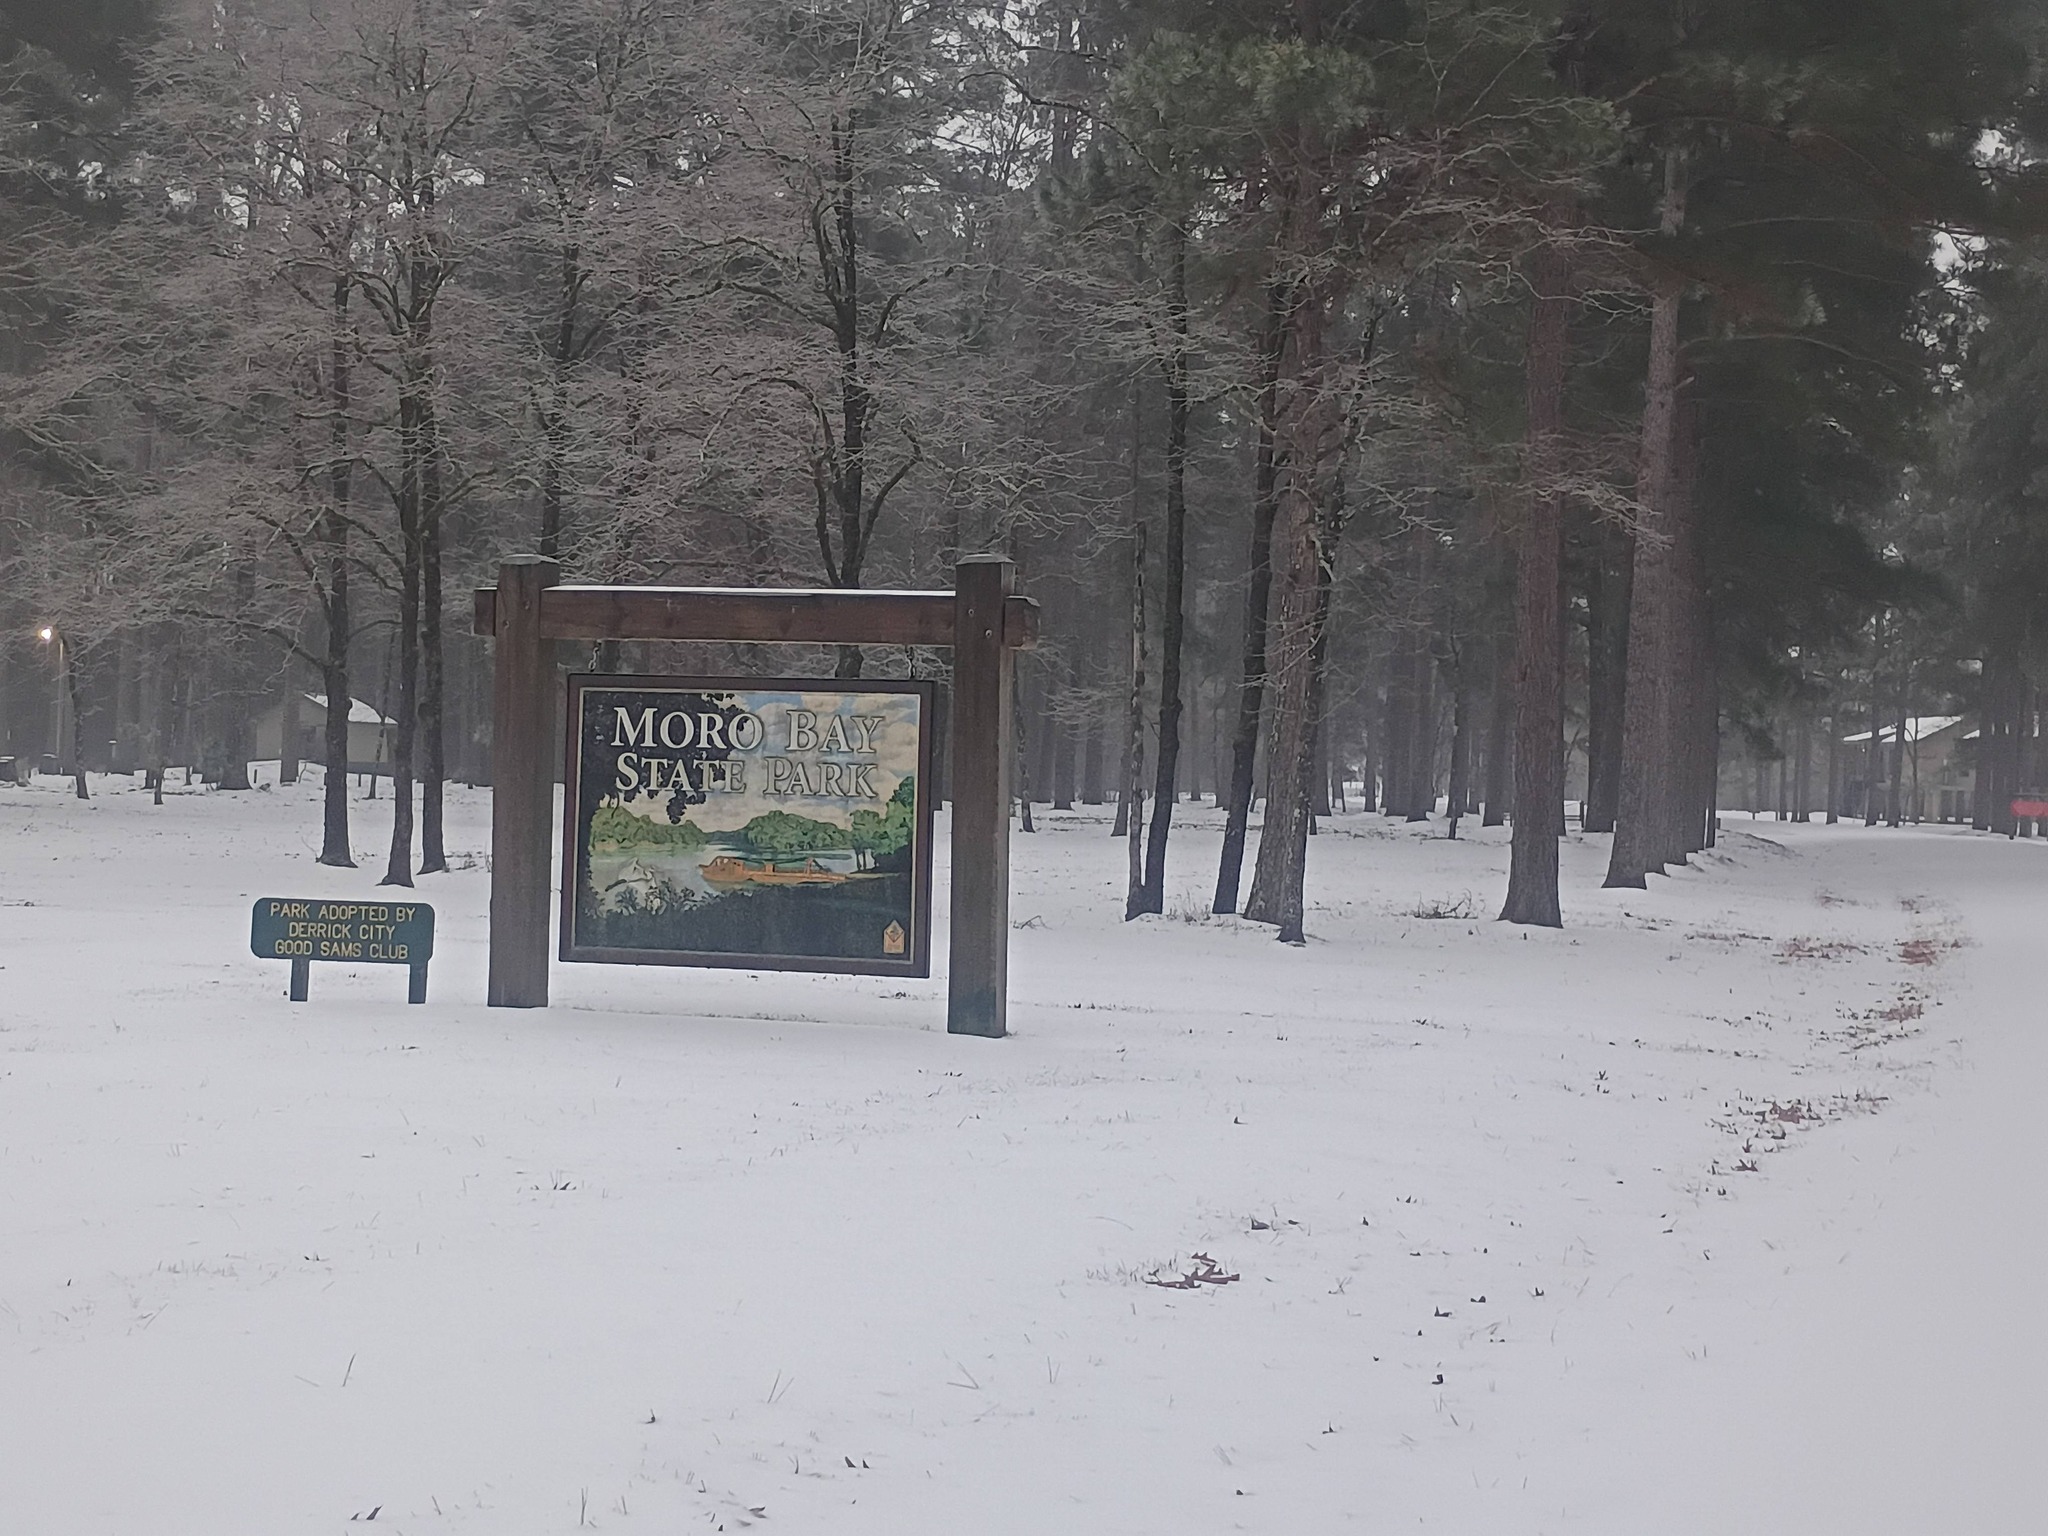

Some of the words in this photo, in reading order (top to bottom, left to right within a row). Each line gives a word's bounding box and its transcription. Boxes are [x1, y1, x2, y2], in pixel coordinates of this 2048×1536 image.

[610, 706, 763, 750] MORO
[785, 710, 885, 753] BAY
[615, 752, 747, 793] STATE
[763, 757, 878, 798] PARK
[270, 903, 310, 919] PARK
[318, 904, 388, 922] ADOPTED
[396, 907, 416, 922] BY
[289, 922, 351, 939] DERRICK
[359, 924, 395, 940] CITY
[275, 940, 312, 955] GOOD
[320, 941, 362, 957] SAMS
[369, 944, 408, 959] CLUB
